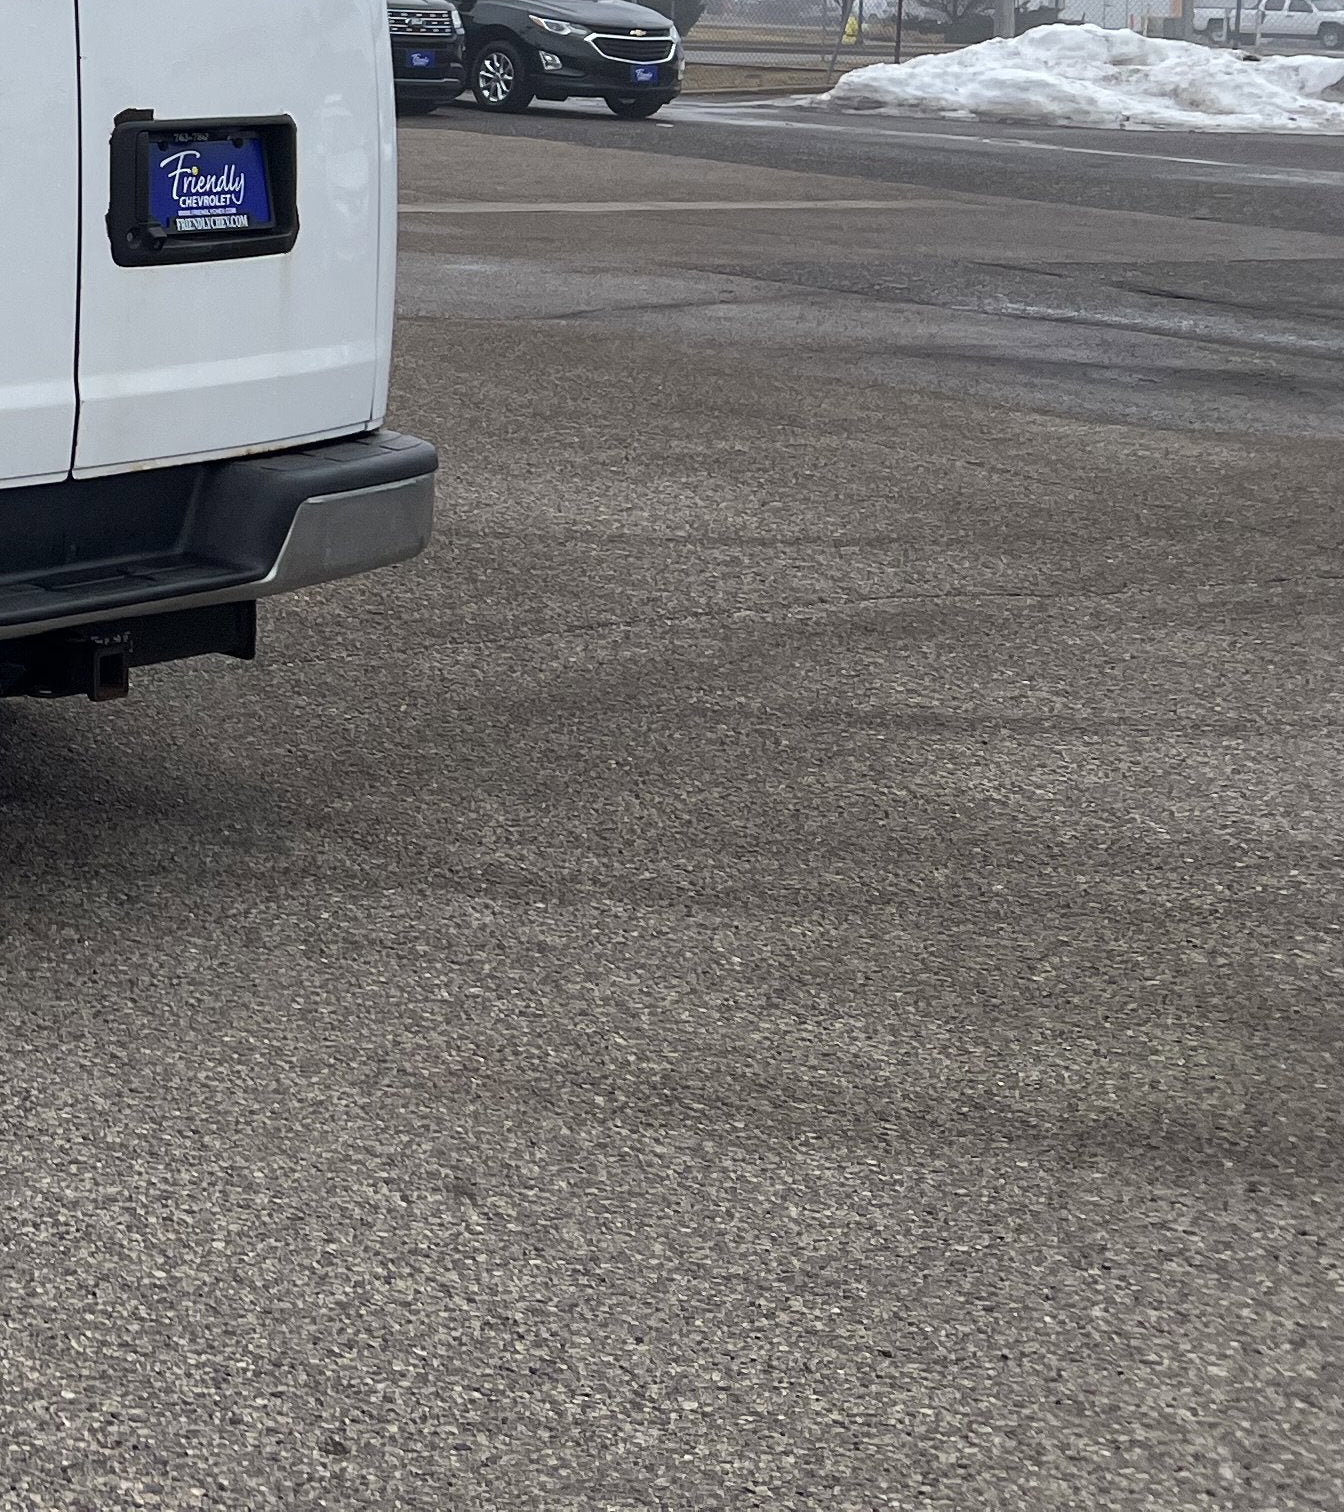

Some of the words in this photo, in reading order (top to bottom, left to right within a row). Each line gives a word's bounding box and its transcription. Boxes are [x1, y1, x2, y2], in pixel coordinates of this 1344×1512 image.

[160, 150, 245, 205] Friendly
[179, 194, 231, 208] CHEVROLET
[175, 214, 249, 232] FRIENDLYCHEV.COM
